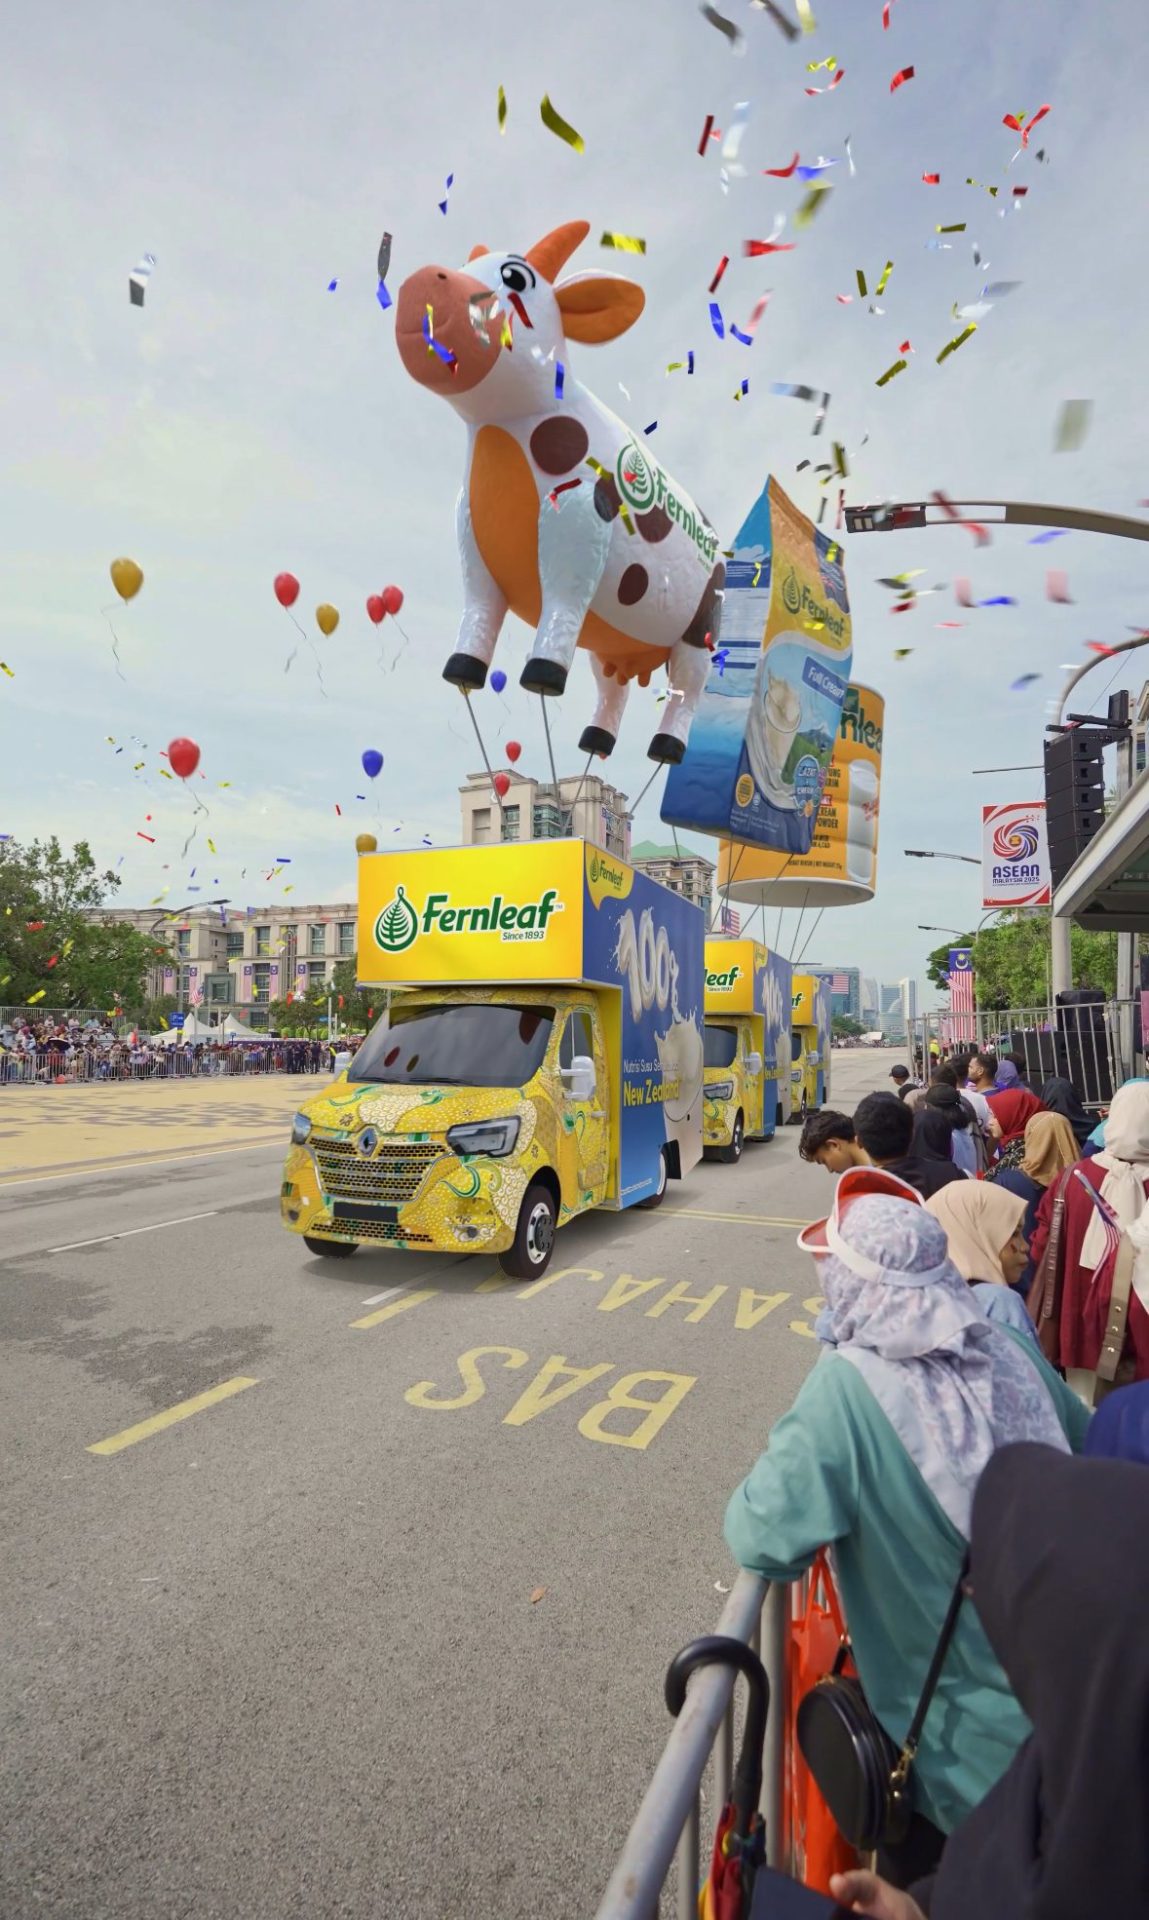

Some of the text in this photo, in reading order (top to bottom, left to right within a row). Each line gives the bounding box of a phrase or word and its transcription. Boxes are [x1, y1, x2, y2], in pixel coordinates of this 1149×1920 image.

[800, 585, 845, 638] Fernleaf
[808, 667, 824, 686] Full
[841, 707, 882, 754] nlea
[599, 860, 624, 887] Fernleaf
[992, 864, 1040, 879] ASEAN
[421, 890, 557, 933] Fernleaf
[502, 931, 544, 940] Since 1893
[704, 967, 738, 986] leaf
[640, 1058, 653, 1073] Susu
[623, 1081, 644, 1107] New
[403, 1345, 698, 1449] BAS
